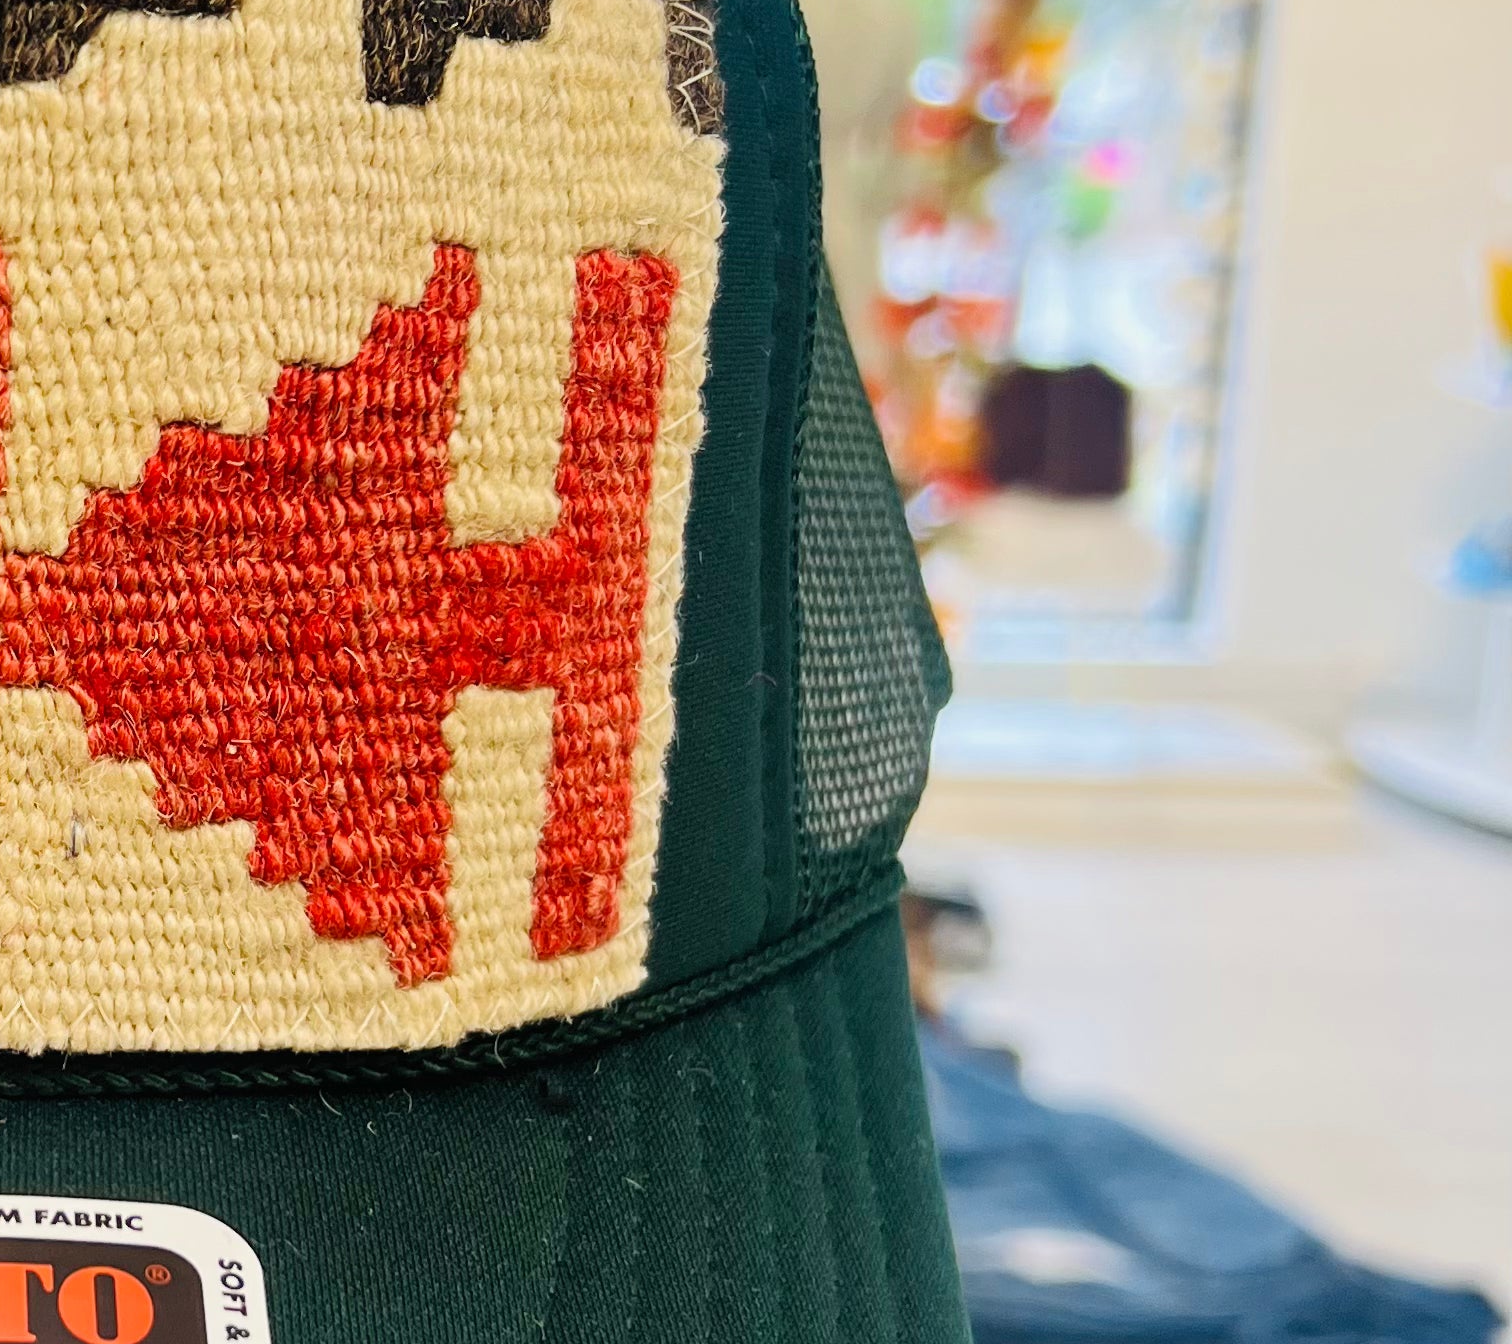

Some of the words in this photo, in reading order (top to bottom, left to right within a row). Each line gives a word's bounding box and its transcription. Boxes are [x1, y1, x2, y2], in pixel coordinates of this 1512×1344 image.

[34, 1209, 143, 1232] FABRIC
[218, 1257, 248, 1318] SOFT
[227, 1325, 251, 1341] &
